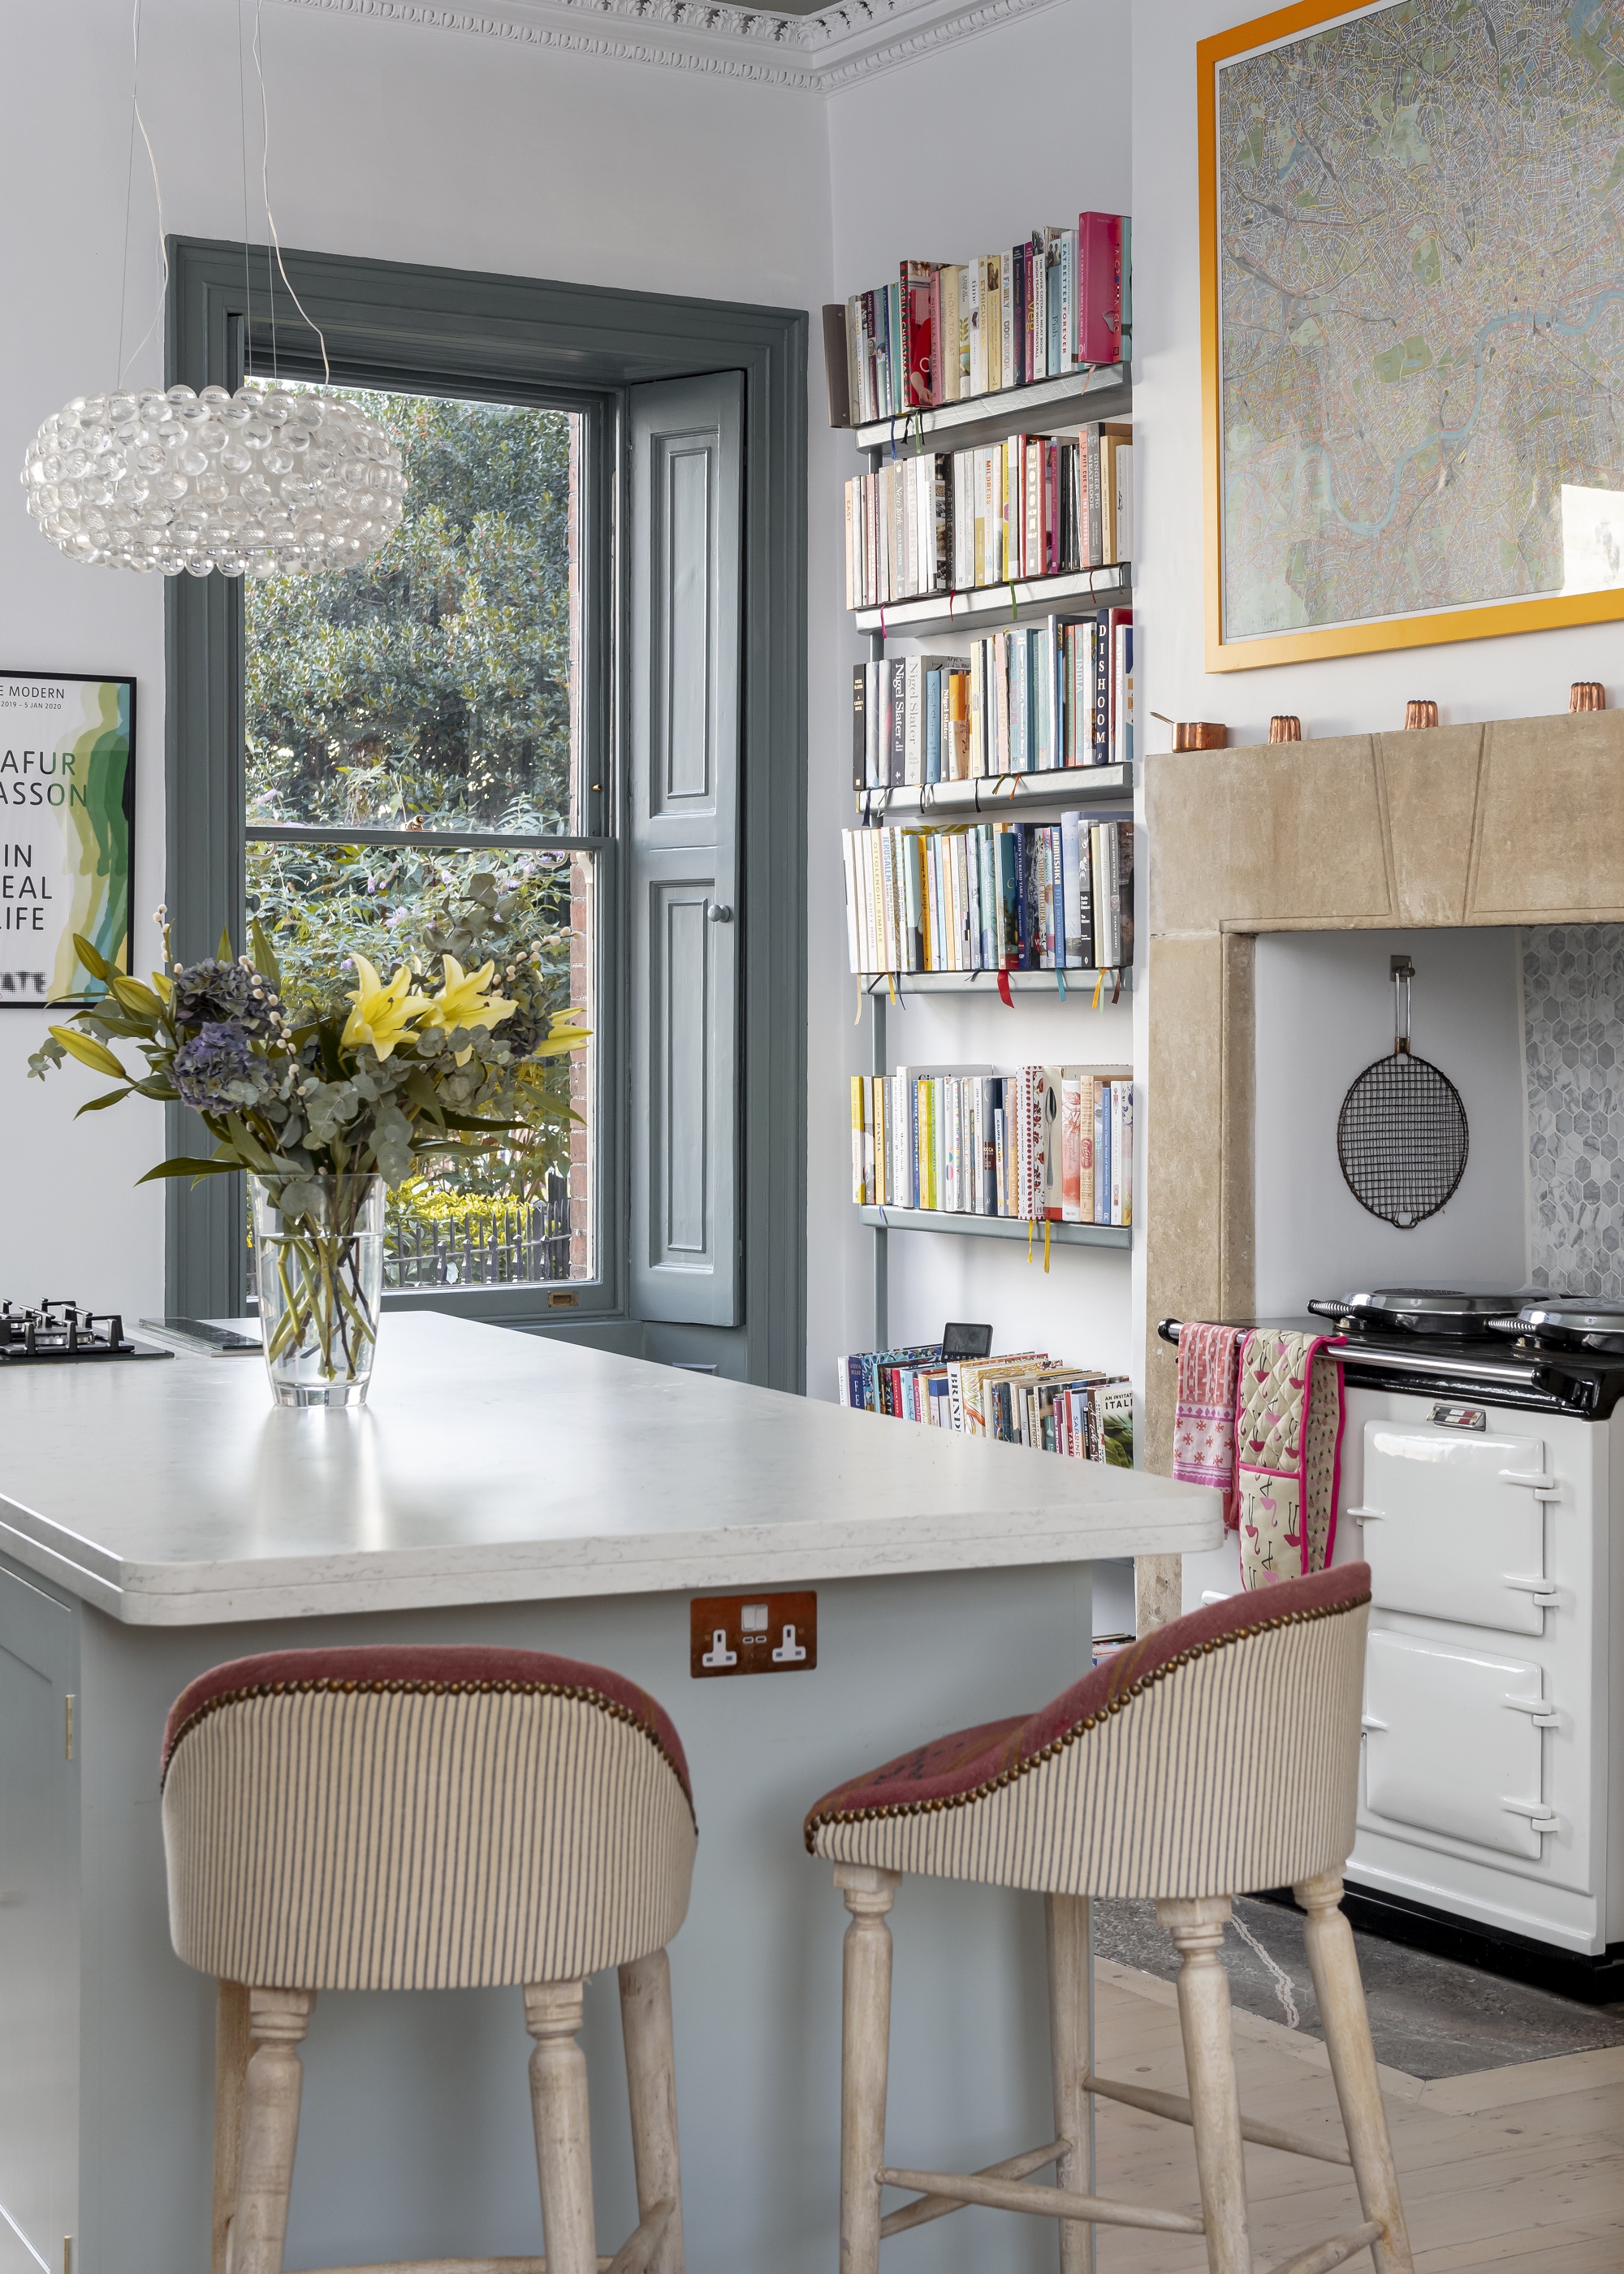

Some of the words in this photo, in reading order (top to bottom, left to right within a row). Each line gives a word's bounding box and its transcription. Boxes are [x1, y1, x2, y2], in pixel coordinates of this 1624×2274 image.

[1002, 277, 1010, 309] FAMILY
[948, 322, 955, 335] TO
[895, 484, 903, 506] New
[896, 506, 904, 525] York
[9, 685, 65, 699] MODERN
[893, 664, 905, 698] Nigel
[907, 663, 919, 698] Nigel
[1096, 625, 1107, 745] DISHOOM
[1, 700, 17, 708] 2019
[998, 674, 1007, 732] LEON
[1009, 680, 1018, 724] LEON
[895, 701, 905, 739] Slater
[909, 703, 919, 745] Slater
[0, 749, 76, 776] AFUR
[4, 844, 32, 868] IN
[883, 836, 892, 882] JERUSALEM
[1052, 832, 1060, 885] MAMUSHKA
[2, 875, 53, 900] EAL
[959, 856, 967, 909] Veggiestan
[0, 906, 45, 932] IFE
[1039, 890, 1047, 926] KITCHENS
[951, 1373, 961, 1432] BRIND
